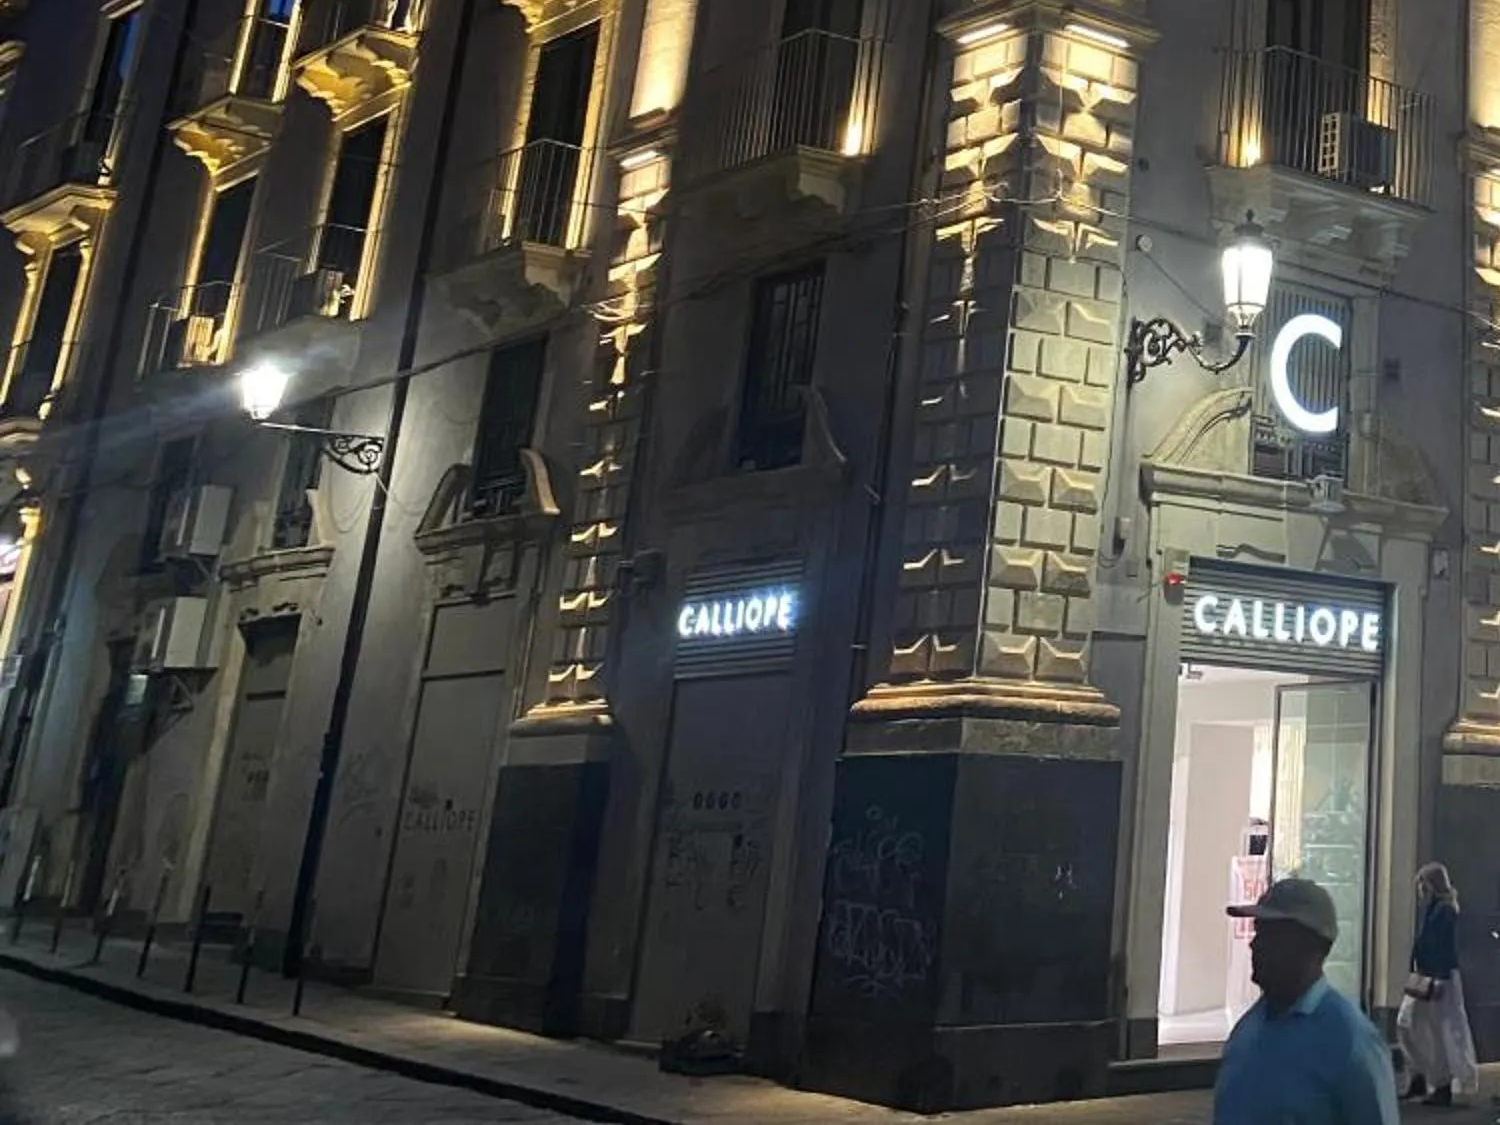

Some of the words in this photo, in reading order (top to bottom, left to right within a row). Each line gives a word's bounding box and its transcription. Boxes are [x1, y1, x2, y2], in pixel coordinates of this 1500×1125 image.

[1270, 313, 1343, 433] C
[678, 591, 796, 637] CALLIOPE
[1194, 595, 1380, 652] CALLIOPE
